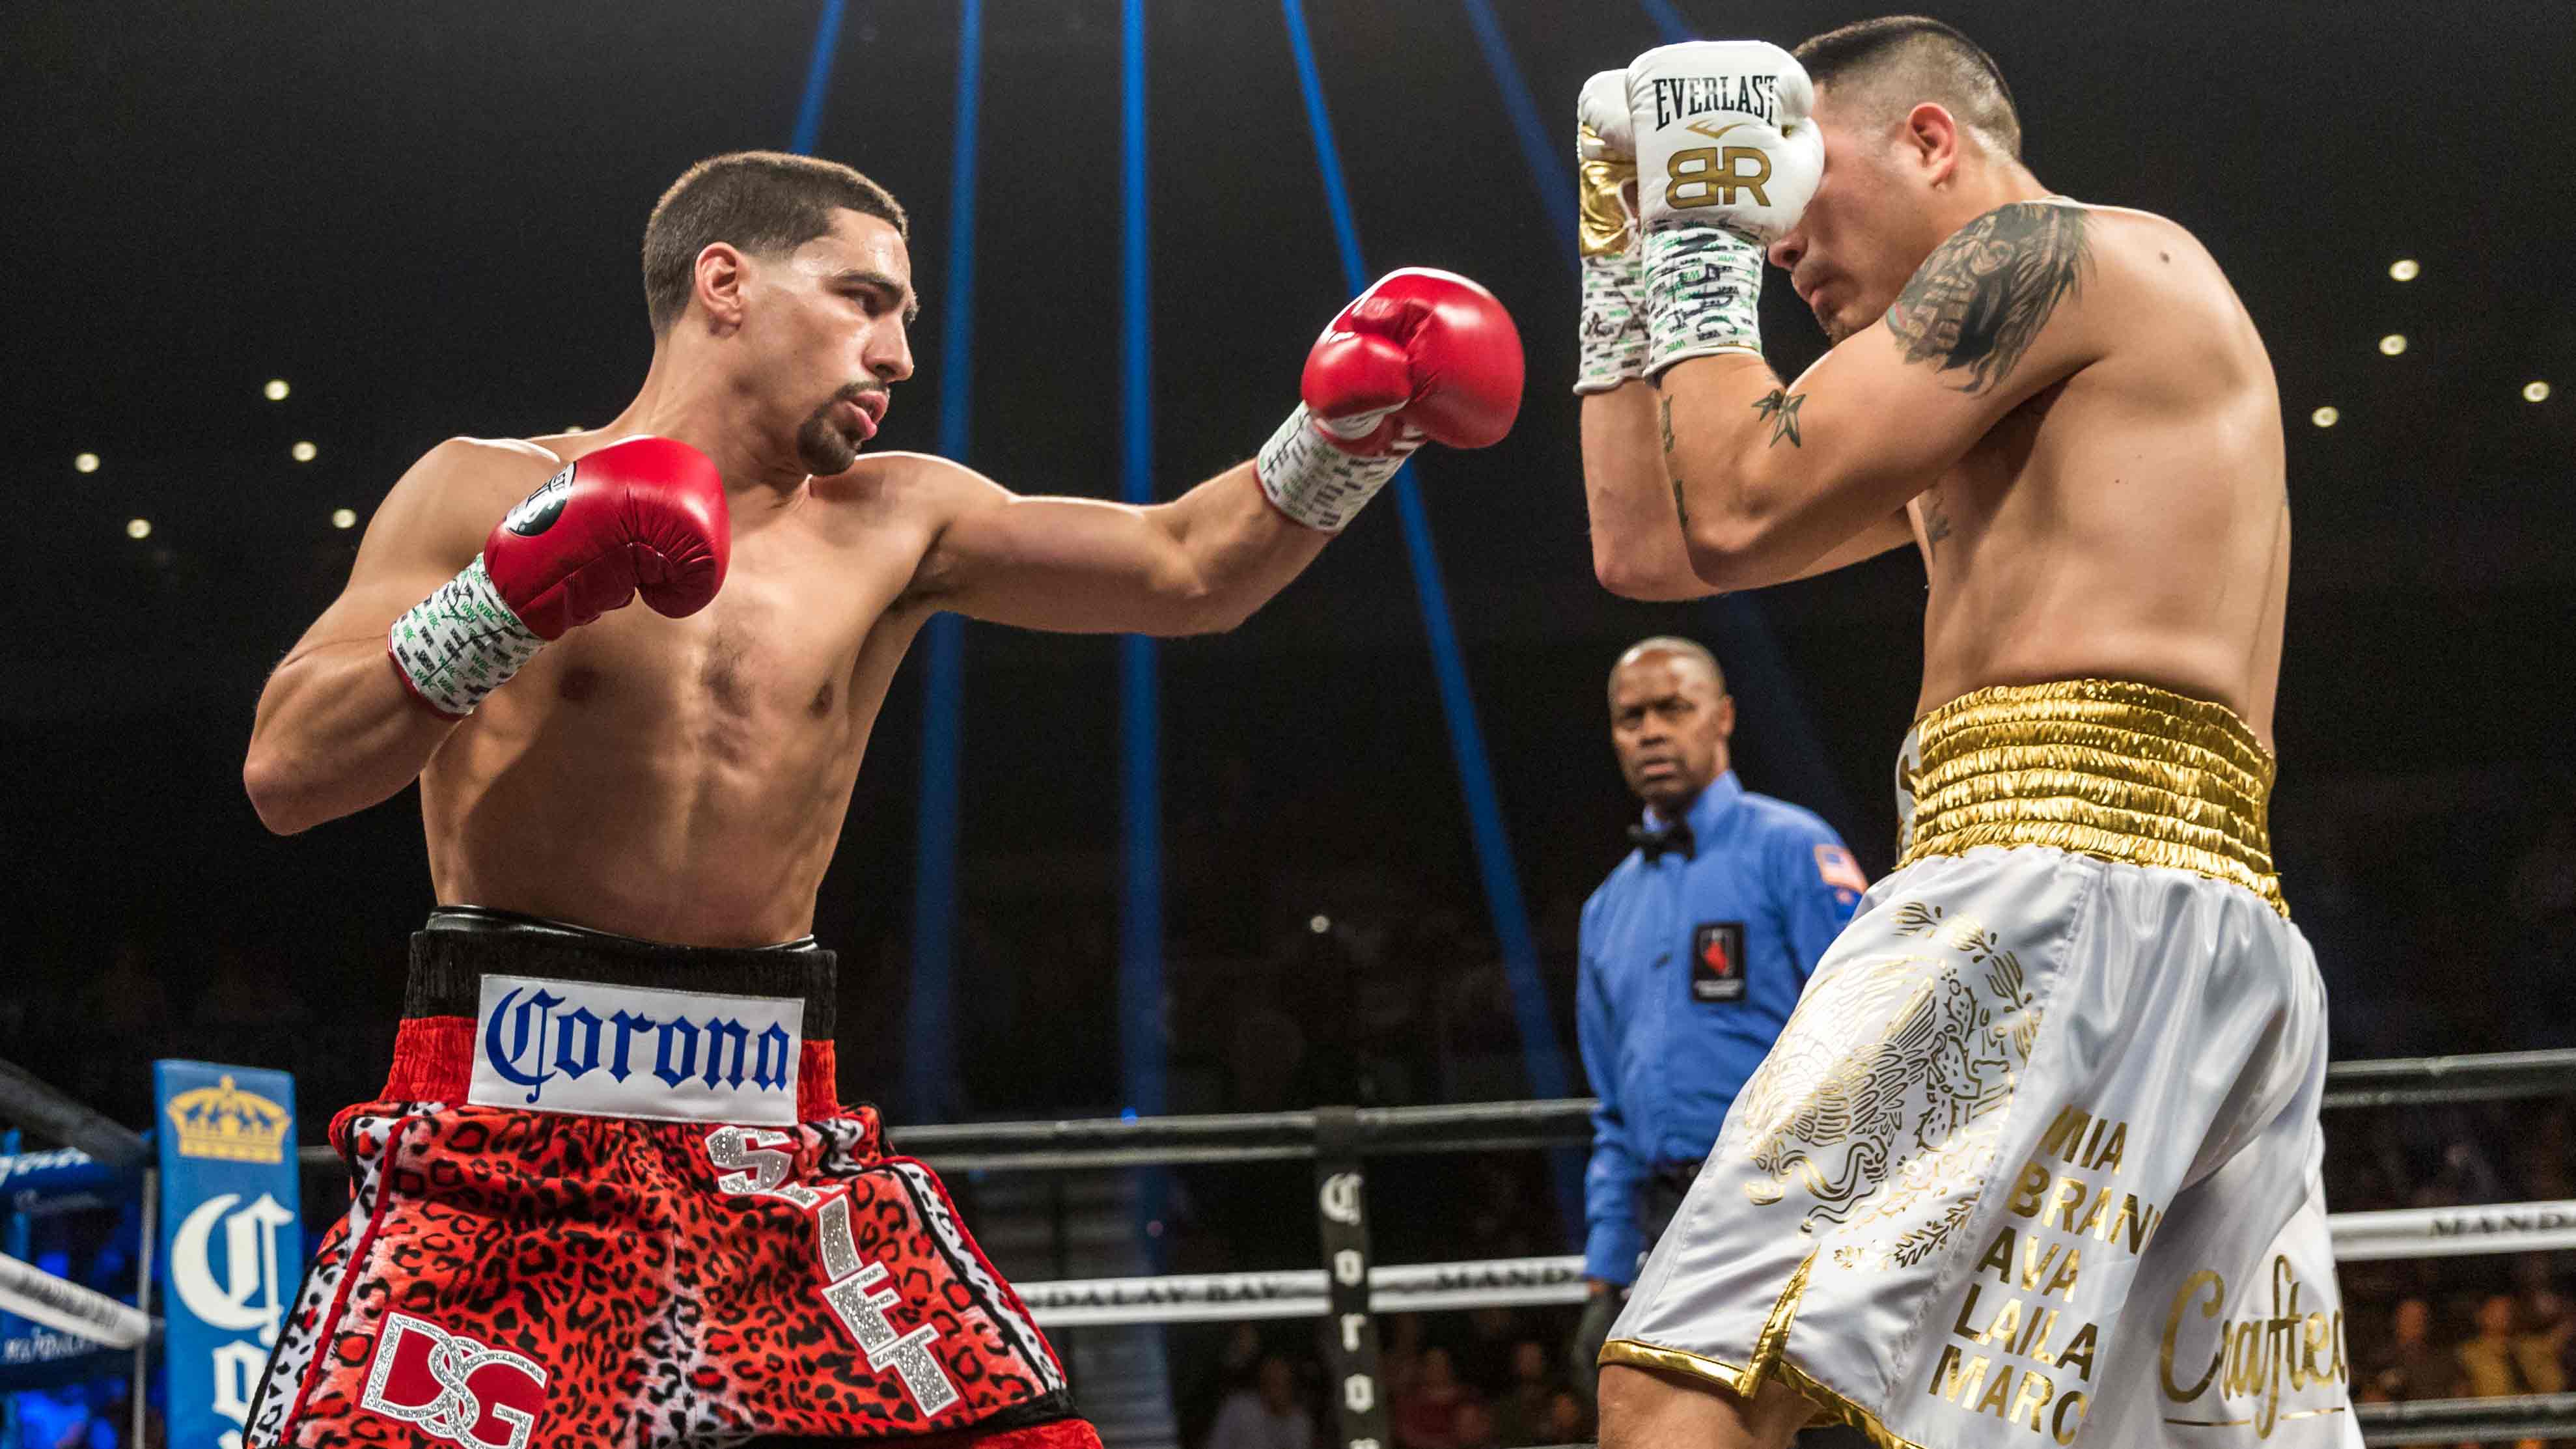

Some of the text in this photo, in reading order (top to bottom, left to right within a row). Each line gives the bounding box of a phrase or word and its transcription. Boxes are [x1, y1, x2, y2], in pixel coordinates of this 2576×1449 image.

[1652, 76, 1779, 131] EVERLAST
[426, 608, 441, 631] WBC
[460, 601, 478, 623] WBC
[477, 600, 499, 623] WBC
[485, 986, 790, 1103] Corona
[2040, 1103, 2127, 1176] MIA
[2007, 1160, 2161, 1255] BRAN
[2429, 1212, 2576, 1237] MAND
[704, 1125, 959, 1417] SIFT
[1434, 1267, 1582, 1290] MAND
[1976, 1226, 2081, 1303] AVA
[1953, 1282, 2098, 1382] LAILA
[361, 1312, 547, 1449] DG
[1928, 1344, 2088, 1446] MARC
